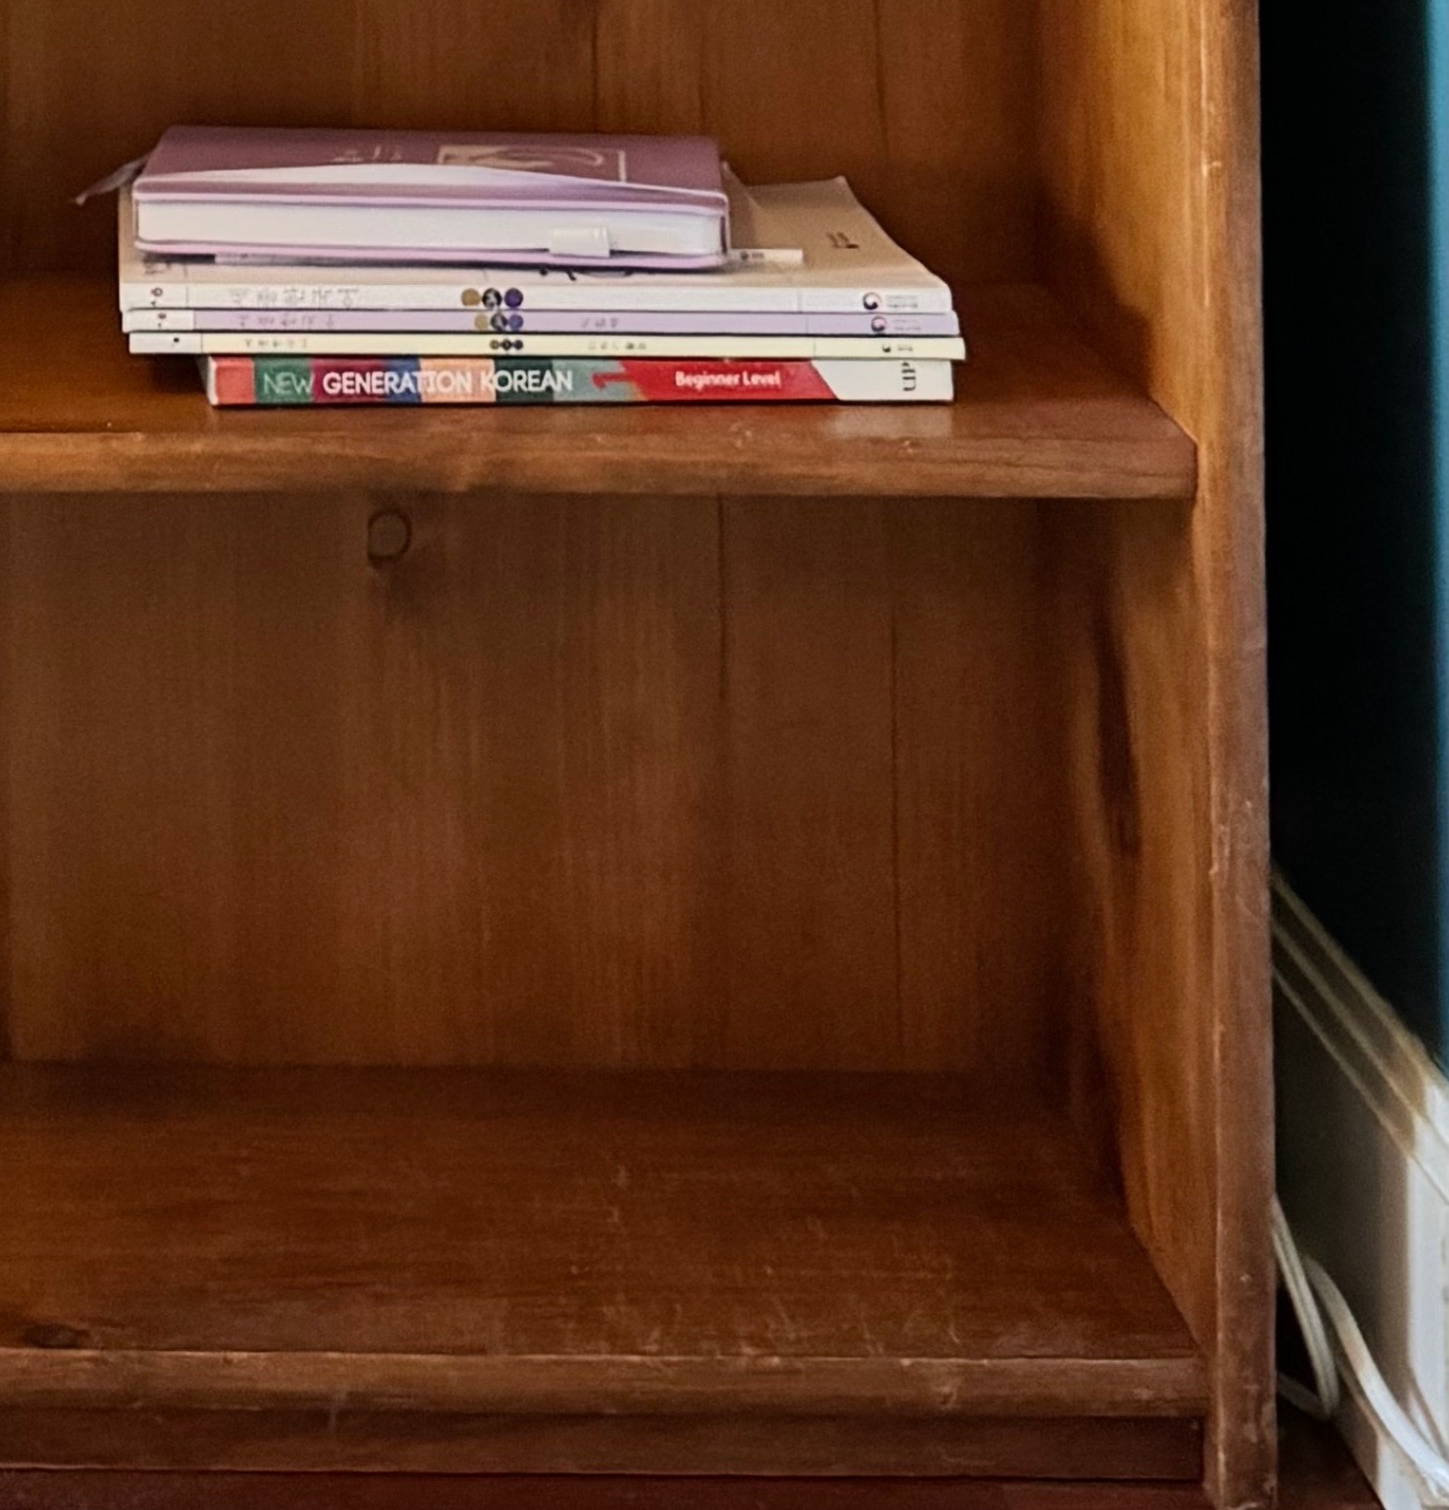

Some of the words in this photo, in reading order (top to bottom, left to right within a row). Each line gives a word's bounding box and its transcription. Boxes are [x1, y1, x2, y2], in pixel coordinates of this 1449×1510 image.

[263, 372, 315, 394] NEW
[323, 371, 472, 395] GENERATION
[480, 370, 573, 393] KOREAN
[675, 370, 739, 388] Beginner
[742, 369, 781, 388] Level
